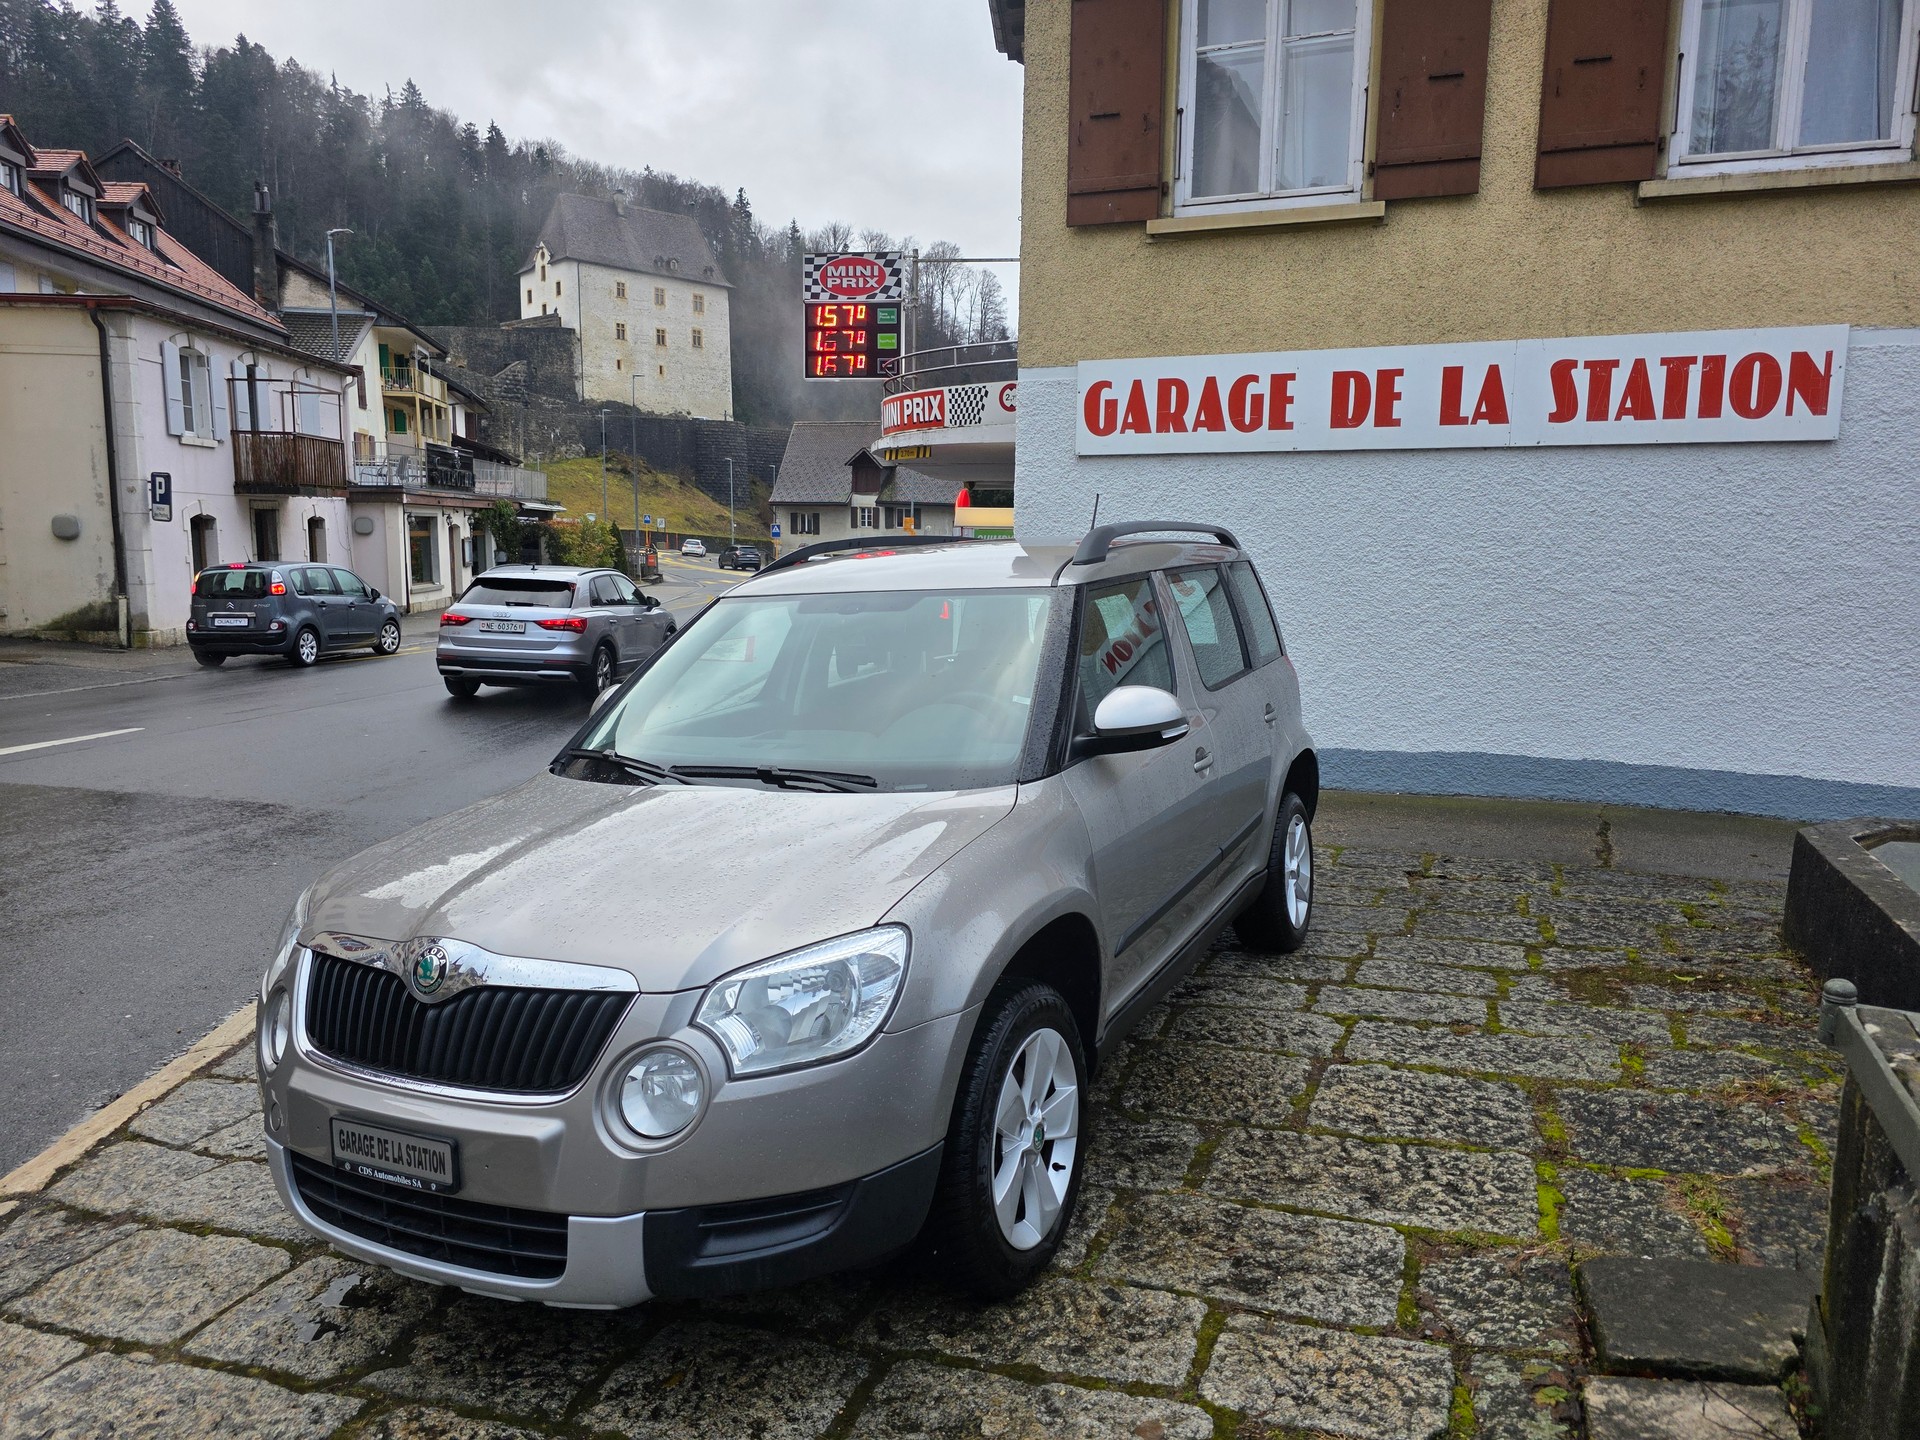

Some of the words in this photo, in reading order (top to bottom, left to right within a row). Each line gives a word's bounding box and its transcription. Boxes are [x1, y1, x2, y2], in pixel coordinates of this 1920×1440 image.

[827, 265, 879, 277] MINI
[827, 277, 880, 288] PRIX
[1084, 373, 1297, 437] GARAGE
[1330, 368, 1404, 429] DE
[1439, 364, 1510, 426] LA
[1548, 350, 1833, 424] STATION
[883, 400, 900, 429] MINI
[903, 395, 942, 424] PRIX
[155, 476, 166, 502] P
[486, 622, 494, 630] NE
[497, 622, 518, 631] 60376
[340, 1129, 375, 1158] GARAGE
[377, 1137, 390, 1162] DE
[391, 1140, 404, 1166] LA
[405, 1144, 446, 1175] STATION
[358, 1165, 372, 1177] CDS
[373, 1170, 411, 1186] Automobiles
[412, 1179, 422, 1189] SA
